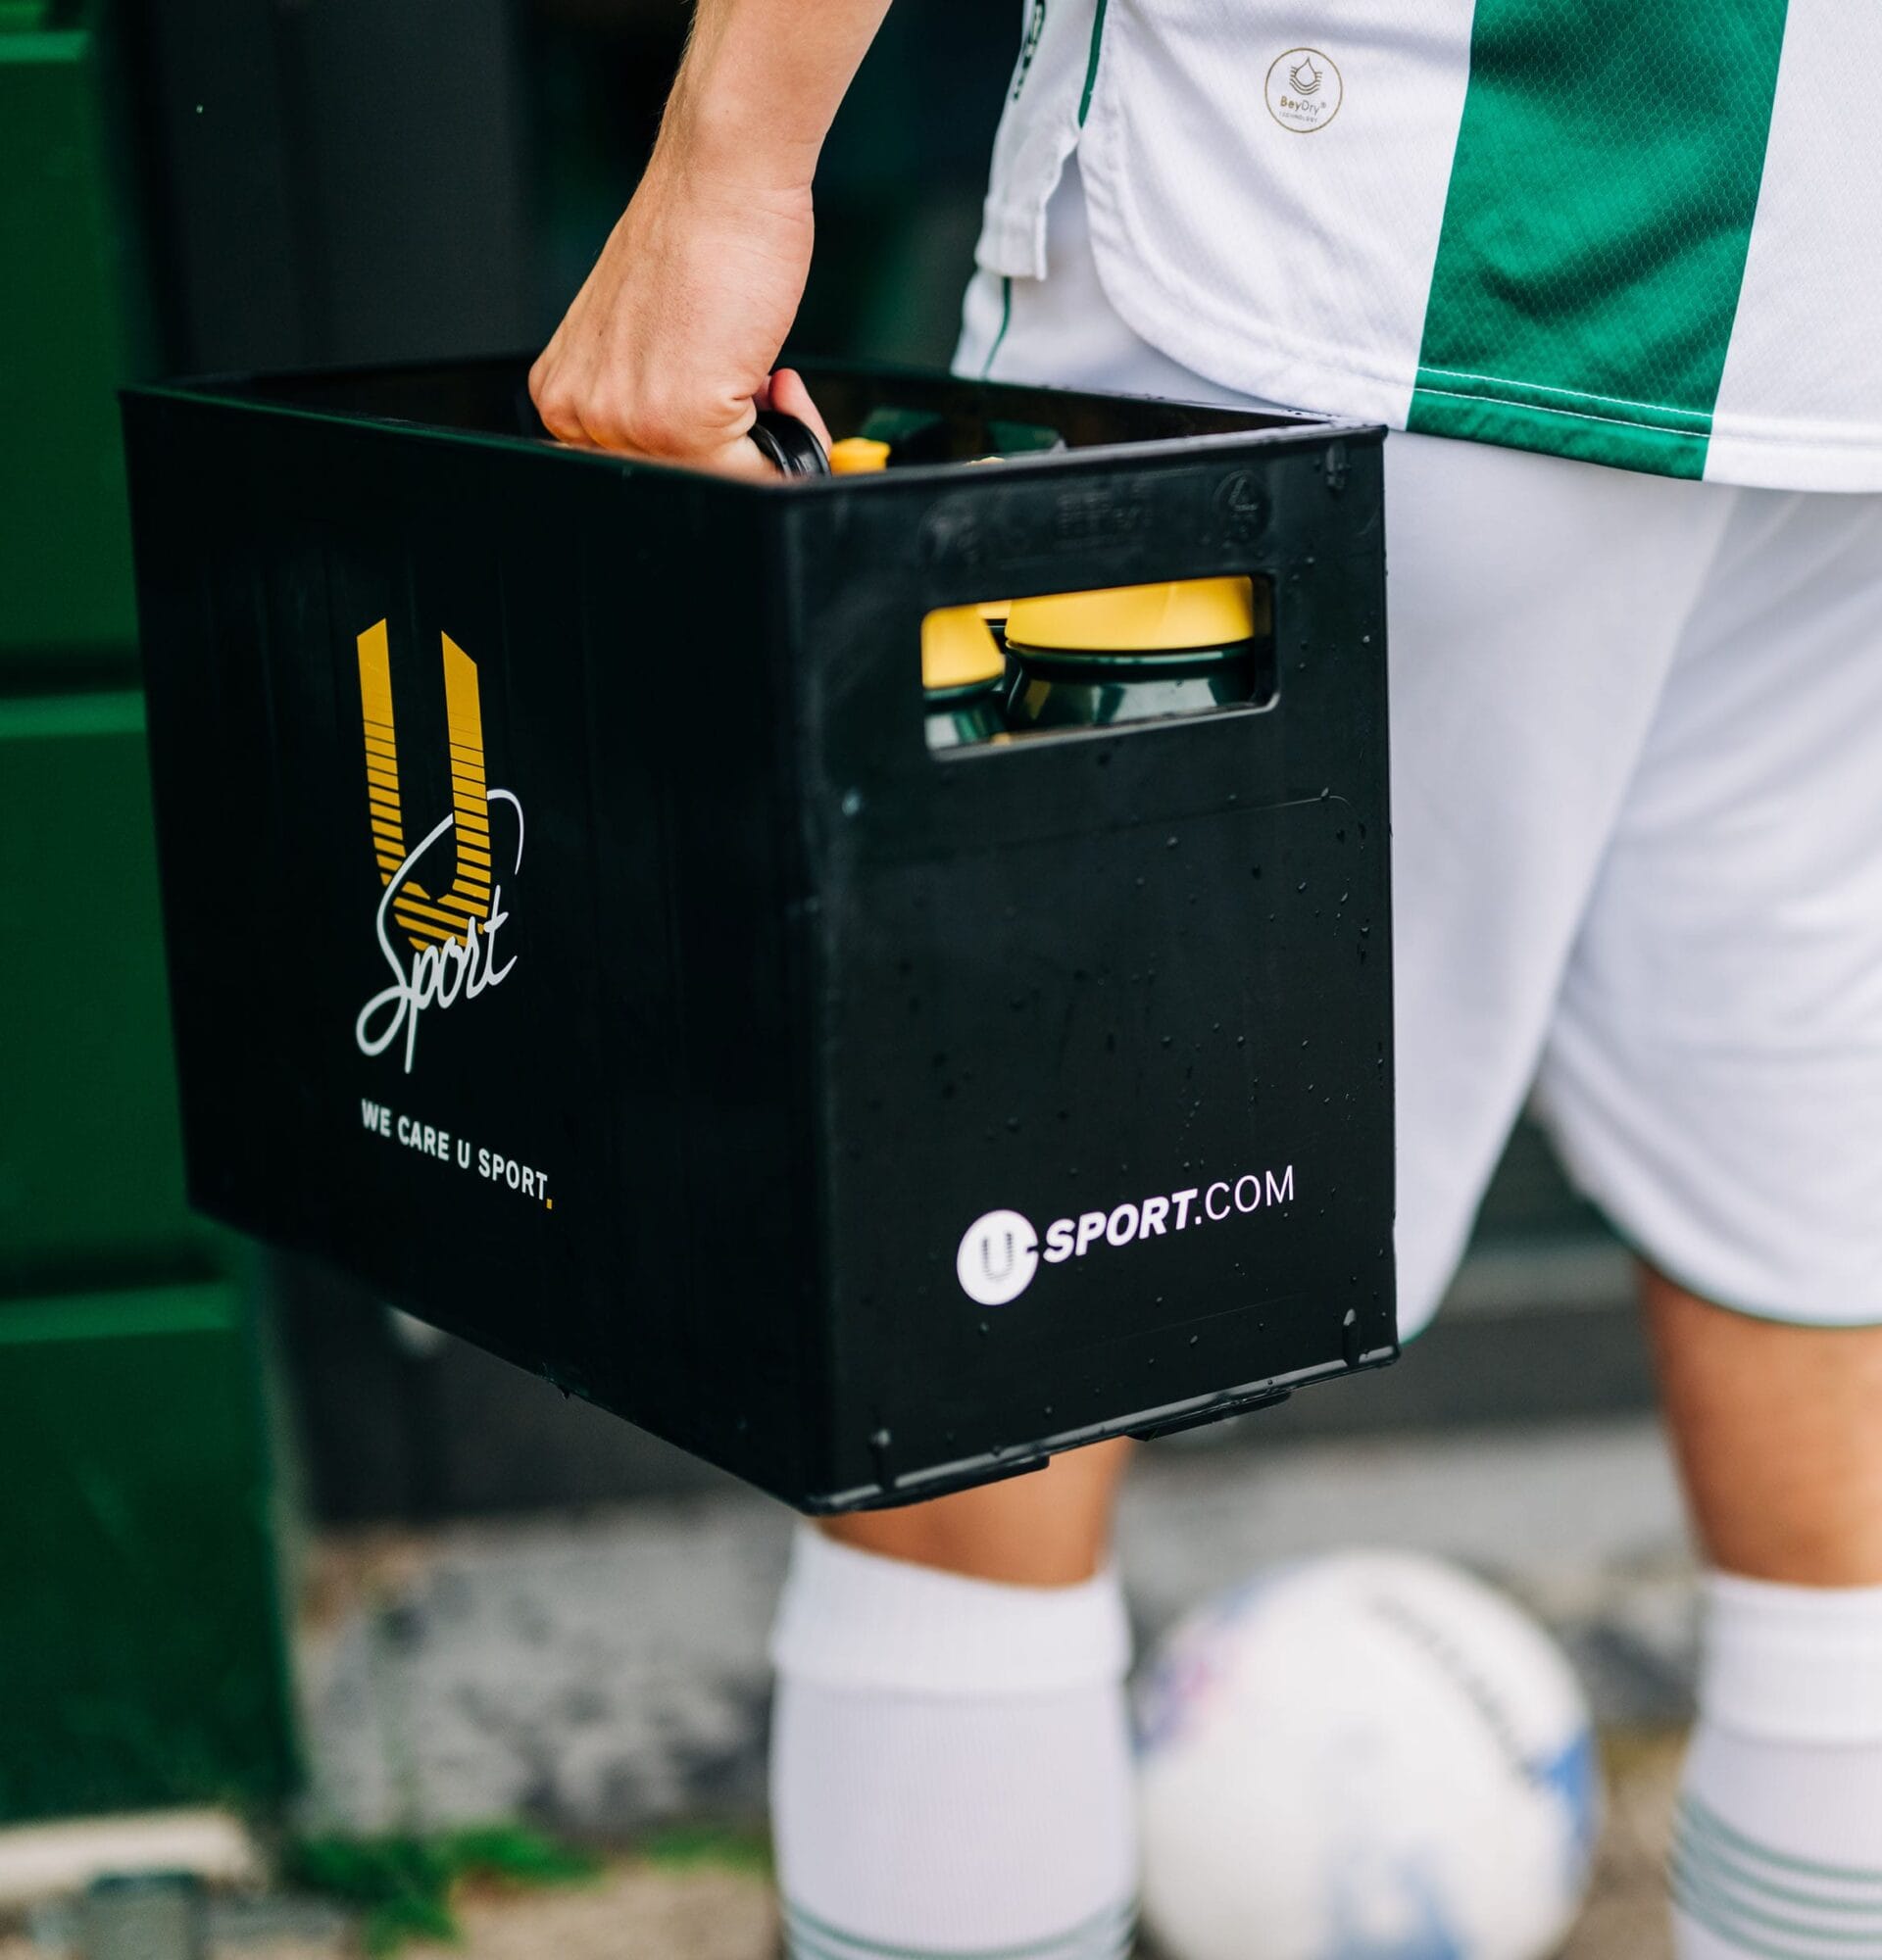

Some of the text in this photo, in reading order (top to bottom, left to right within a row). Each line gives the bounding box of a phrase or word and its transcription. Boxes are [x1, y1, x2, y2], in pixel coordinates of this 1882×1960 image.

[357, 618, 492, 952] U
[356, 788, 524, 1074] Sport
[361, 1098, 553, 1210] WE CARE U SPORT.
[1042, 1164, 1295, 1264] SPORT.COM
